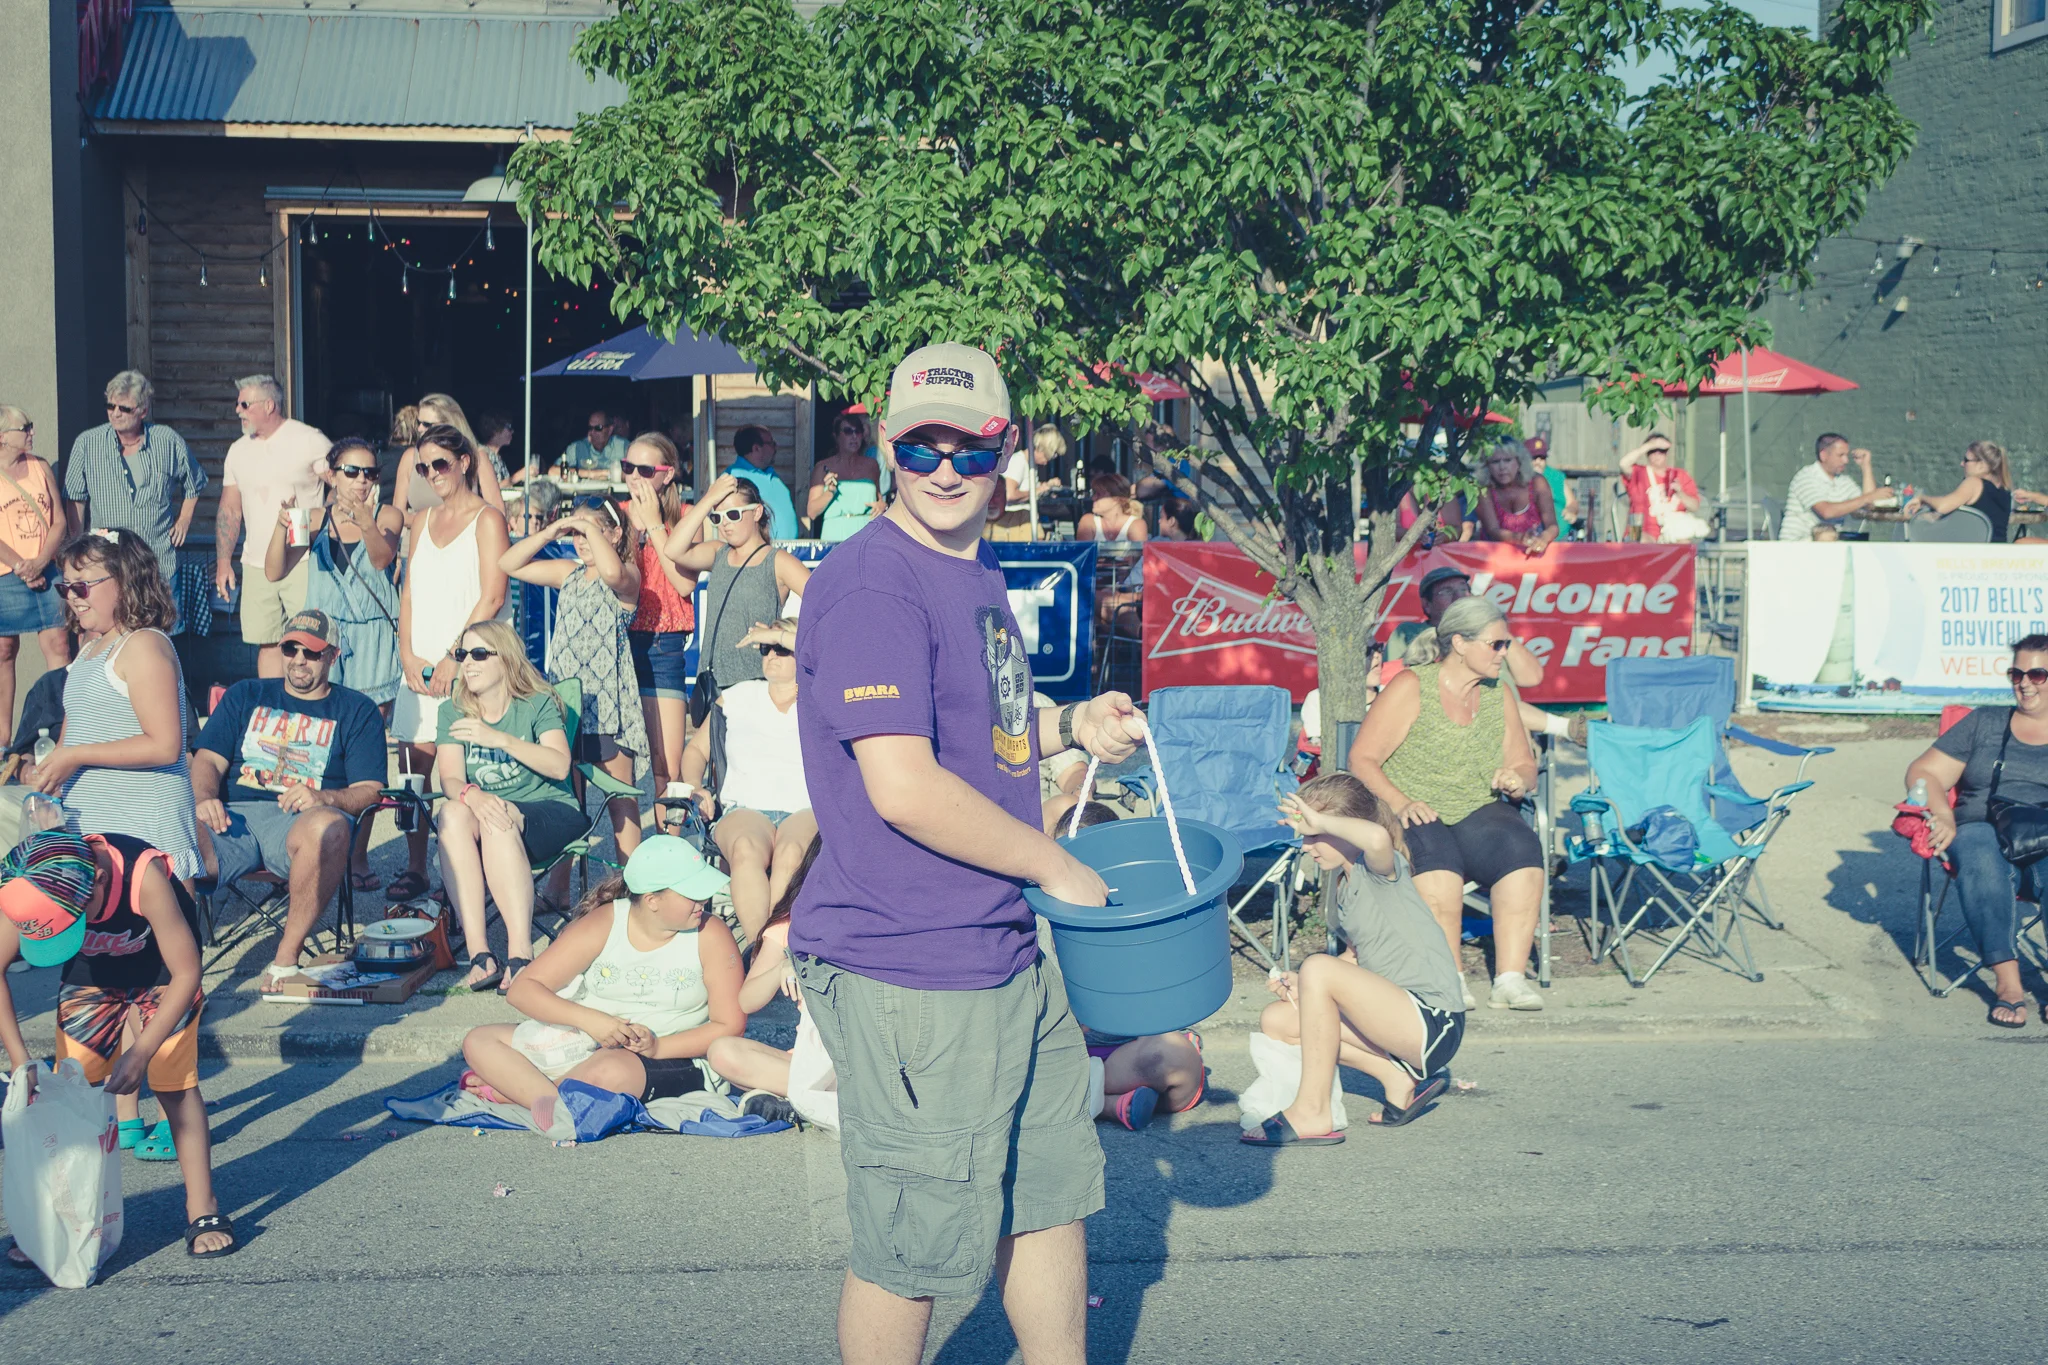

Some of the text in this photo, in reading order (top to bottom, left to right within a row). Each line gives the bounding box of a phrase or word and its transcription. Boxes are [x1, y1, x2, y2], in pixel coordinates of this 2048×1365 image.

[912, 371, 926, 384] TSC
[925, 377, 963, 386] SUPPLY
[927, 368, 974, 381] TRACTOR
[1940, 586, 2043, 613] 2017 BELL'S
[1172, 596, 1312, 636] Budwe
[1942, 620, 2021, 646] BAYVIEW
[1561, 626, 1690, 667] Fans
[1940, 656, 2008, 675] WELC
[844, 685, 899, 699] BWARA
[252, 706, 334, 747] HARD
[37, 927, 53, 938] SB
[84, 929, 131, 951] IKE
[309, 990, 373, 1000] FREE DELIVERY
